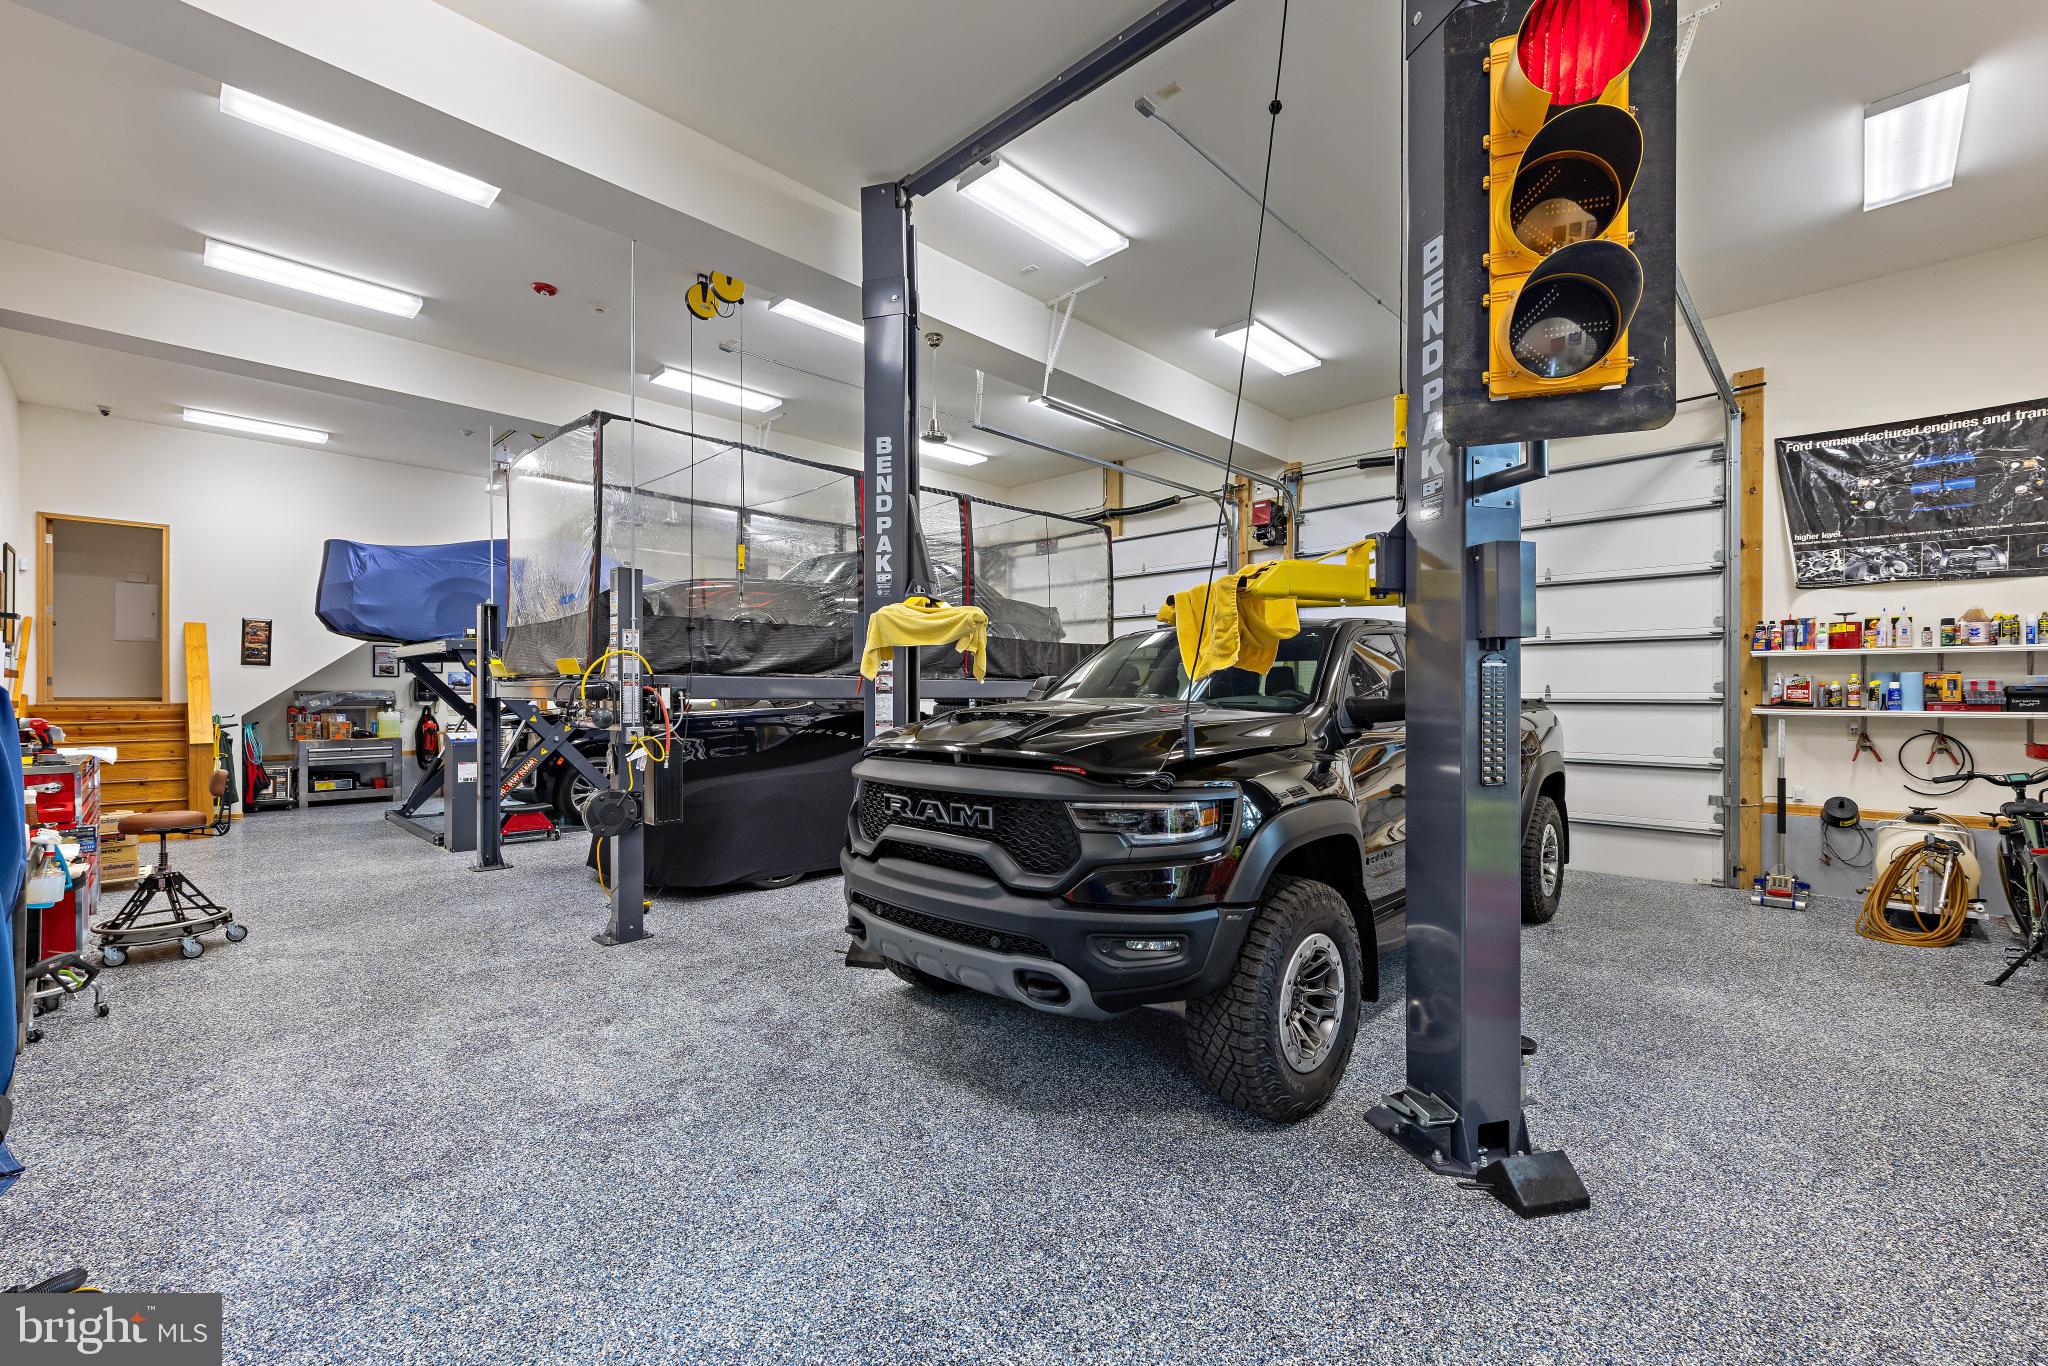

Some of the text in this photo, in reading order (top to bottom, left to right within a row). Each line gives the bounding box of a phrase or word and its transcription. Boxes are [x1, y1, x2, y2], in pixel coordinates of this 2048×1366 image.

[1422, 235, 1444, 479] BENDPAK
[1786, 441, 1812, 453] Ford
[1816, 424, 1919, 448] remanufactured
[1923, 418, 1979, 433] engines
[1983, 411, 2011, 425] and
[876, 436, 892, 572] BENDPAK
[1794, 533, 1820, 541] higher
[883, 793, 992, 829] RAM
